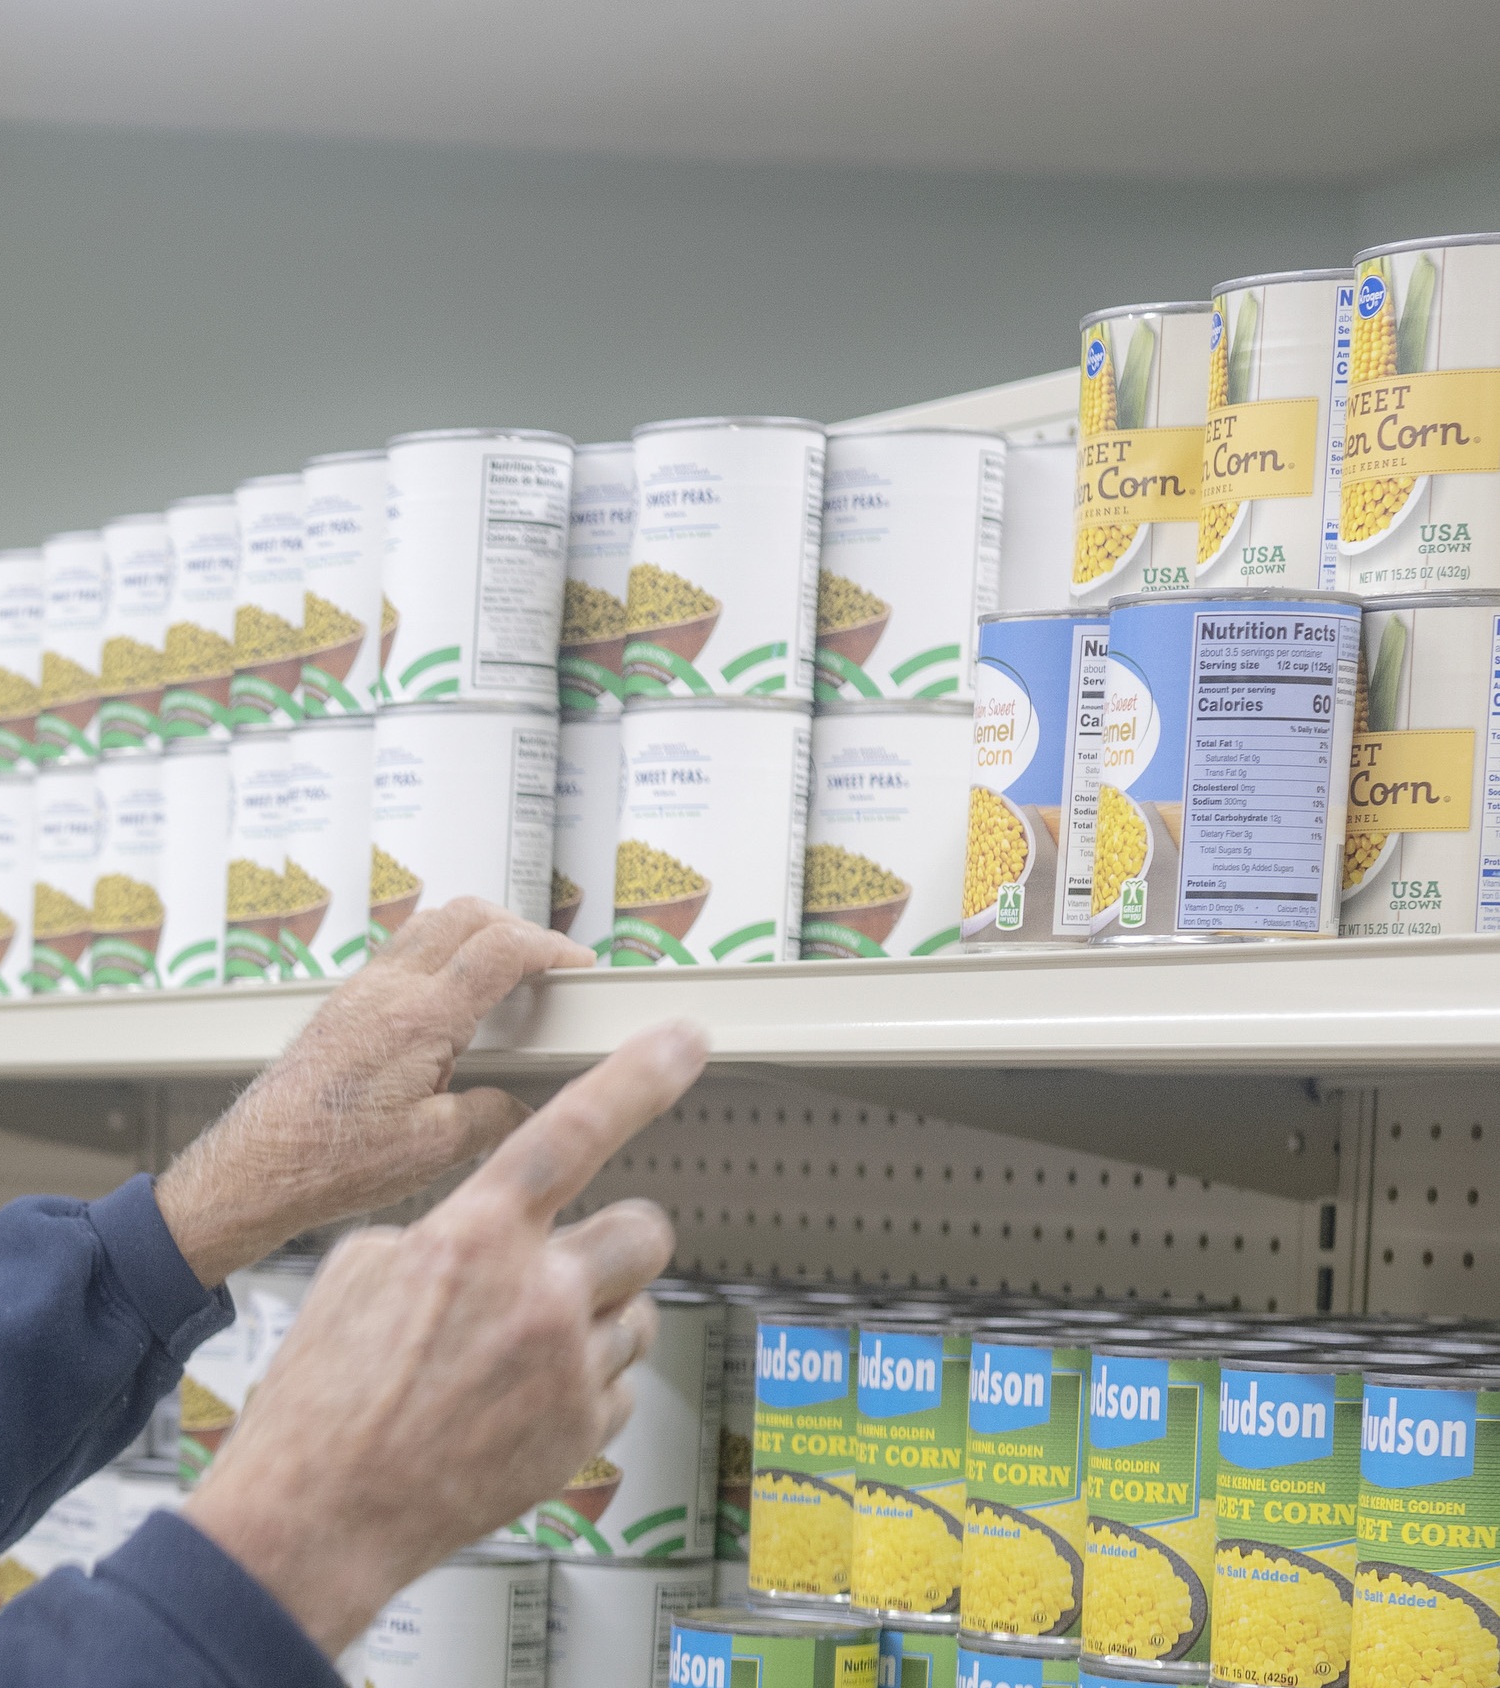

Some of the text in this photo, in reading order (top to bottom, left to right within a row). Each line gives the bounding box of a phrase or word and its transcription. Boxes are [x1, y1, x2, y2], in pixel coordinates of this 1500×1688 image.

[1359, 284, 1385, 310] Kroger
[1377, 414, 1469, 451] Corn
[1214, 443, 1285, 478] Corn
[1360, 458, 1407, 472] KERNEL
[1098, 466, 1186, 499] Corn
[1421, 523, 1471, 542] USA
[1242, 545, 1285, 564] USA
[1418, 542, 1471, 555] GROWN
[1143, 567, 1189, 584] USA
[1240, 564, 1285, 575] GROWN
[1360, 565, 1470, 584] NET WT 15.25 OZ (432g)
[1201, 621, 1336, 642] Nutrition Facts
[1201, 648, 1323, 659] about 3.5 servings per container
[1200, 660, 1334, 674] Serving size 1/2 cup (125g)
[1199, 686, 1276, 695] Amount per serving
[987, 697, 1017, 716] Sweet
[1198, 695, 1331, 714] Calories 60
[1235, 740, 1243, 749] 1g
[977, 747, 1013, 767] Corn
[1104, 746, 1134, 767] Corn
[1206, 754, 1237, 762] Saturated
[1240, 754, 1250, 762] Fat
[1252, 754, 1260, 763] 0g
[1239, 769, 1247, 778] 0g
[1193, 784, 1255, 793] Cholesterol 0mg
[1350, 770, 1440, 807] Corn
[1192, 798, 1222, 806] Sodium
[1192, 814, 1268, 823] Total Carbohydrate
[1201, 830, 1243, 839] Dietary Fiber
[1201, 846, 1217, 854] Total
[1219, 846, 1242, 855] Sugars
[1252, 864, 1272, 872] Added
[1187, 880, 1216, 888] Protein
[1392, 881, 1441, 899] USA
[1000, 907, 1019, 917] GREAT
[1123, 904, 1142, 914] GREAT
[1389, 900, 1441, 910] GROWN
[1006, 915, 1018, 924] YOU
[1130, 912, 1141, 922] YOU
[1348, 923, 1404, 936] WT 15.25 OZ
[1219, 1381, 1326, 1439] Hudson
[1270, 1479, 1326, 1494] GOLDEN
[1408, 1500, 1466, 1516] GOLDEN
[1401, 1523, 1498, 1549] CORN
[1251, 1568, 1299, 1584] Added
[1364, 1589, 1437, 1609] Salt Added
